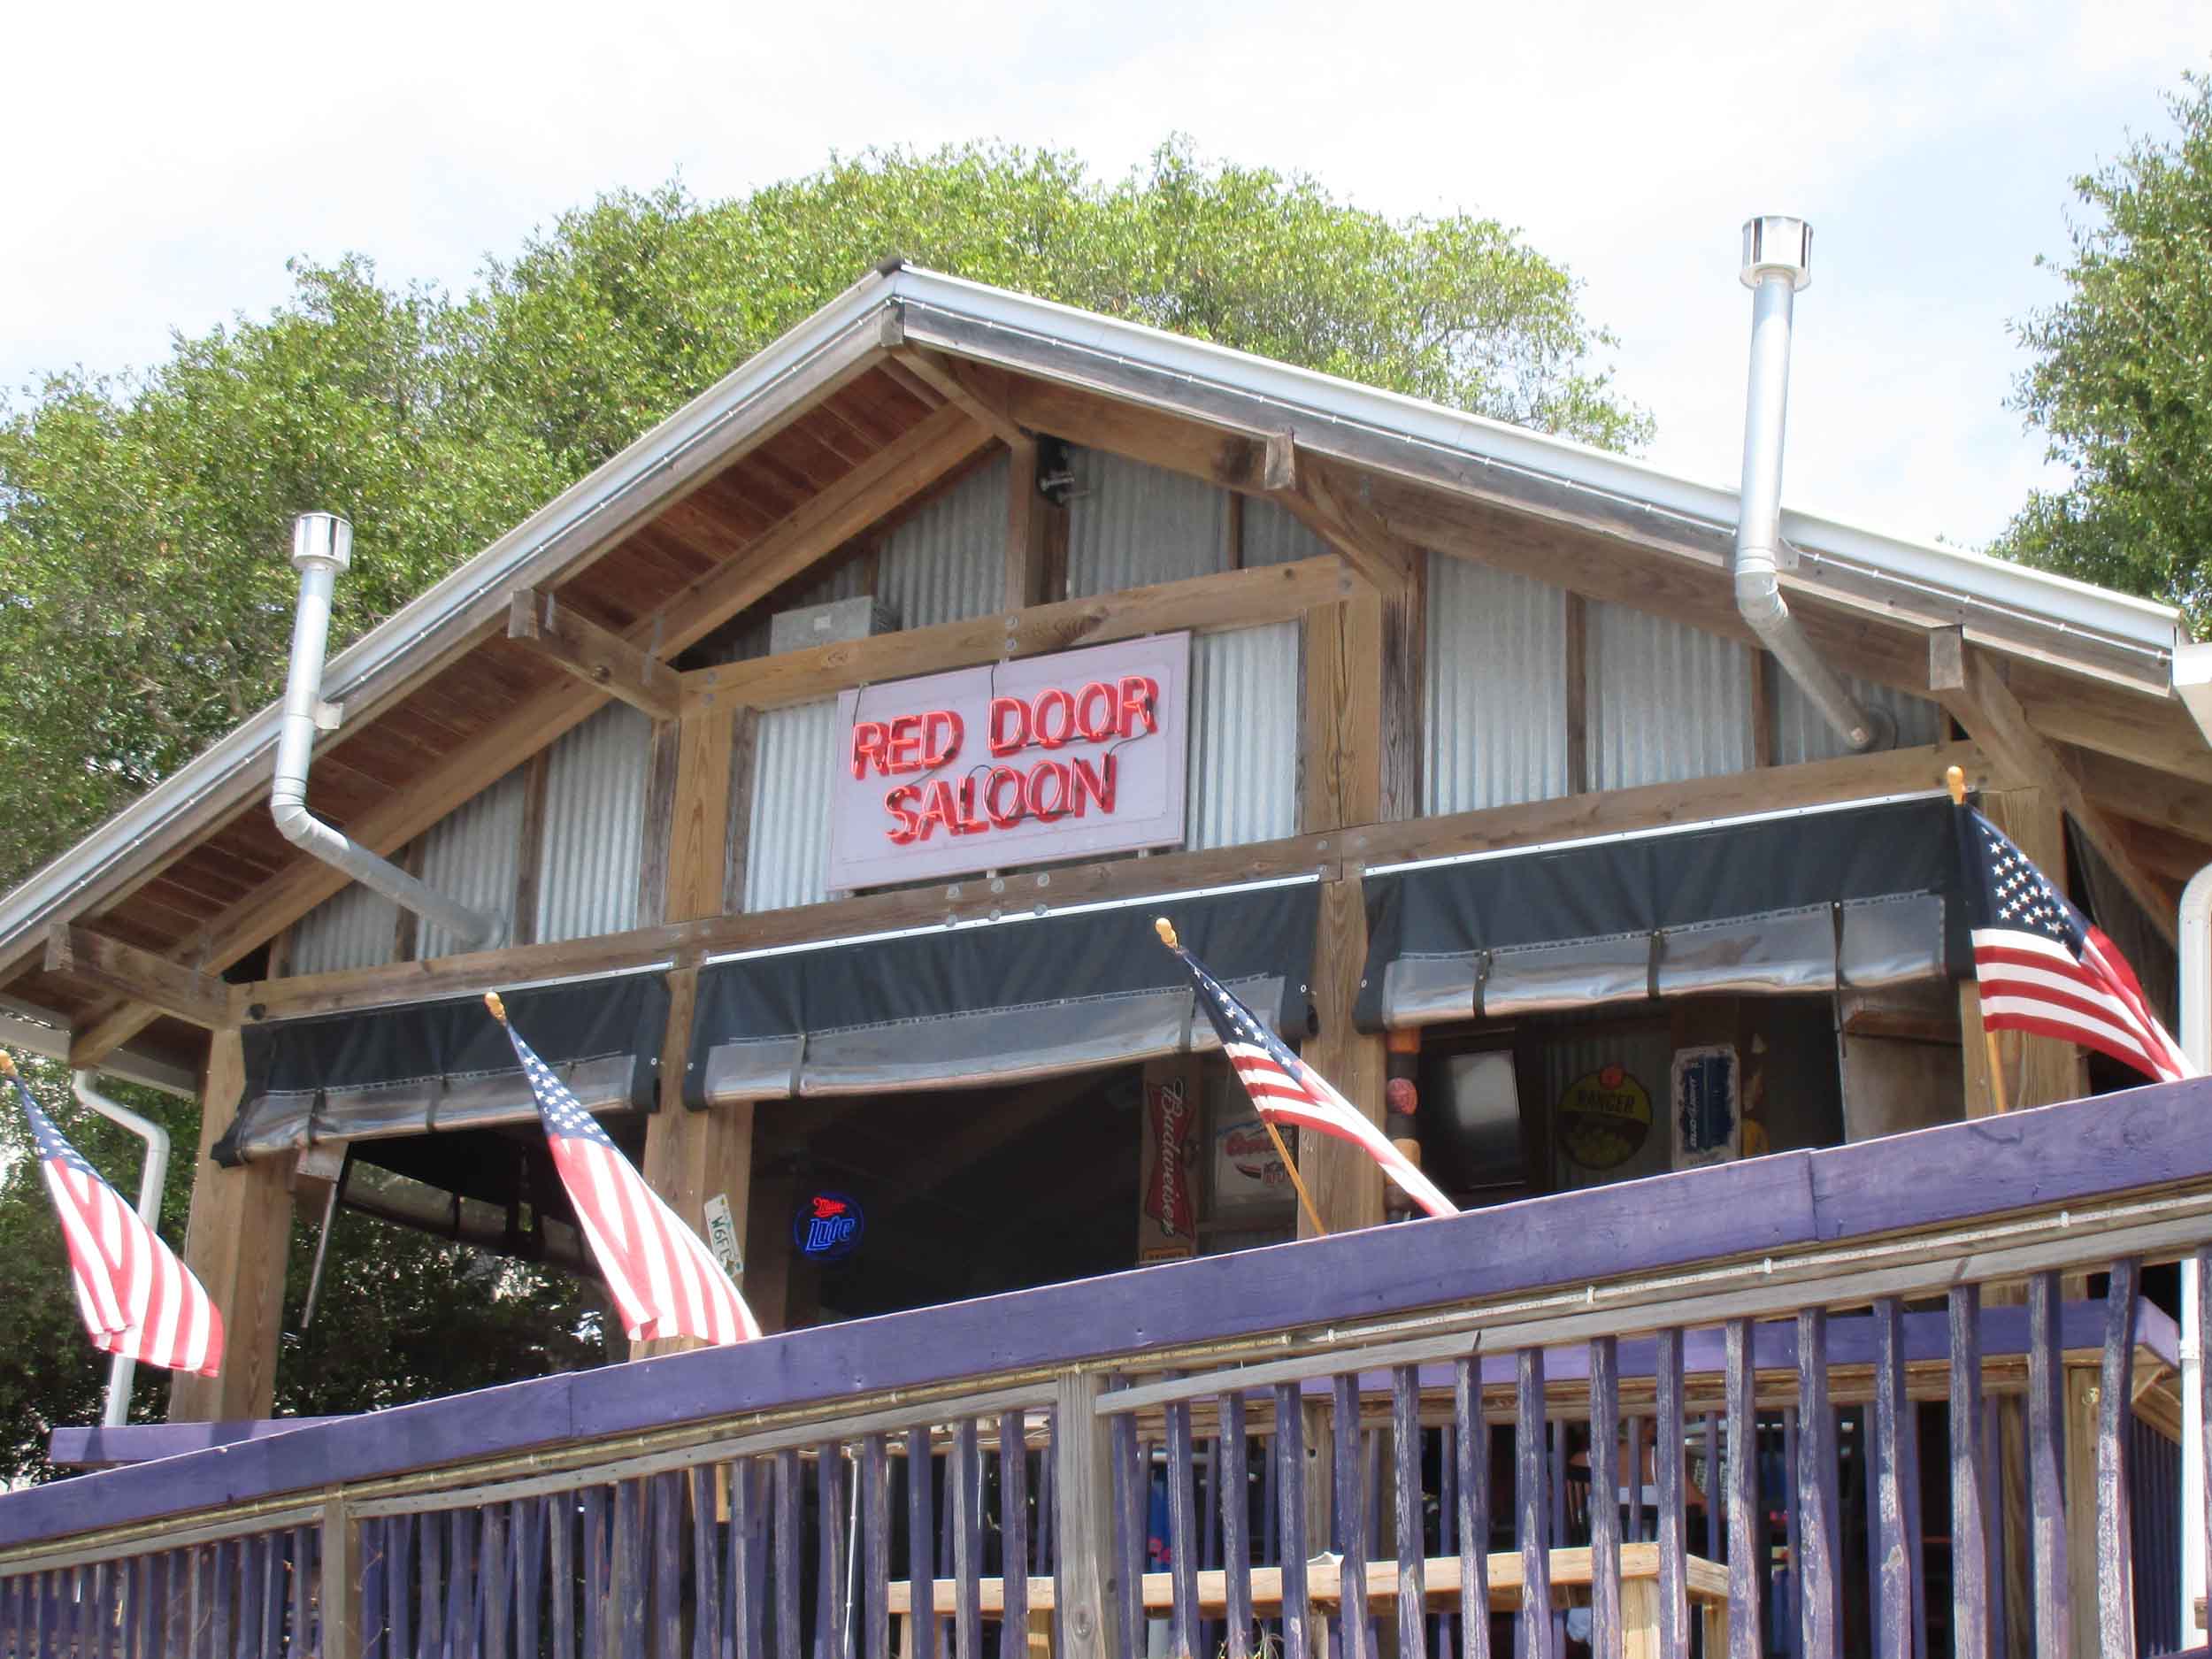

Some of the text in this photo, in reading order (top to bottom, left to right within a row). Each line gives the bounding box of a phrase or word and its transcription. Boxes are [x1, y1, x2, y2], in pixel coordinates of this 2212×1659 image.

[850, 675, 1159, 780] RED DOOR
[885, 753, 1118, 845] SALOON
[1160, 1075, 1185, 1237] Budweiser
[805, 1216, 856, 1252] Lite
